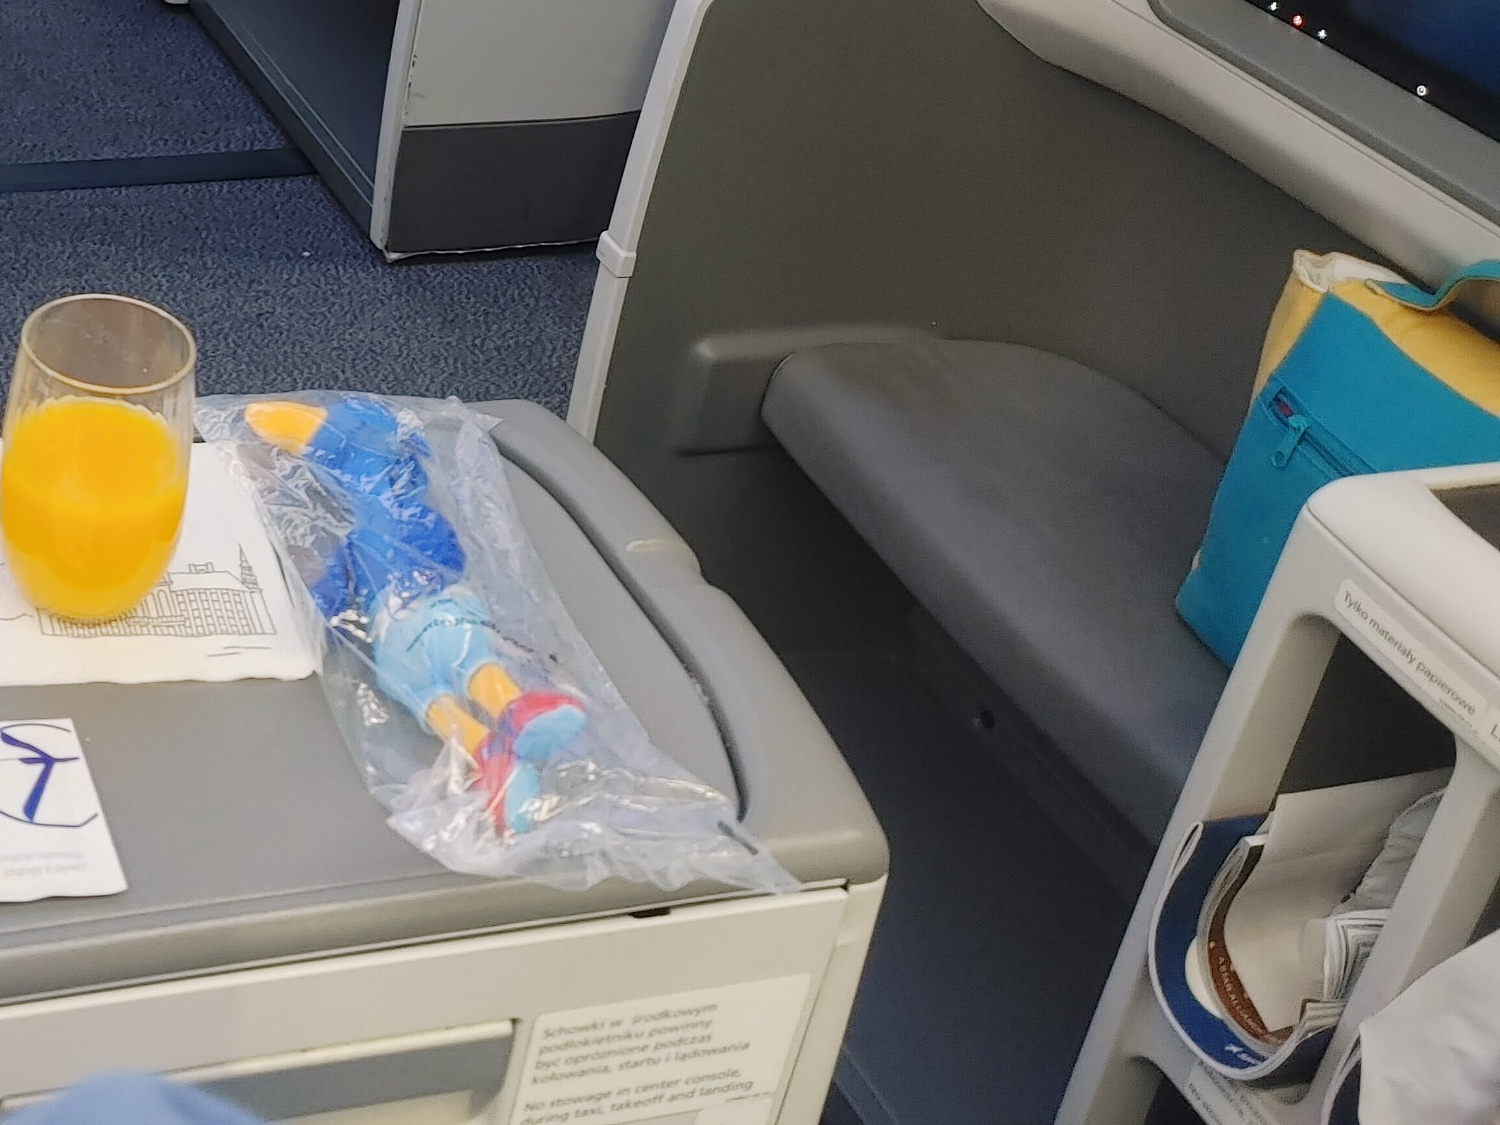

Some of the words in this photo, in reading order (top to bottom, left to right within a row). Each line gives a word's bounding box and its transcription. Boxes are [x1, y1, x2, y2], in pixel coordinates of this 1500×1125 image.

[1344, 590, 1369, 621] Tylko
[1415, 660, 1477, 716] papierowe
[609, 1019, 623, 1028] w
[648, 1019, 713, 1039] powinny
[653, 1033, 712, 1053] podczas
[618, 1057, 661, 1071] startu
[524, 1101, 545, 1112] No
[549, 1090, 612, 1108] stowage
[616, 1087, 631, 1096] in
[634, 1078, 681, 1094] center
[610, 1093, 665, 1112] takeoff
[667, 1088, 696, 1103] and
[698, 1080, 754, 1097] landing
